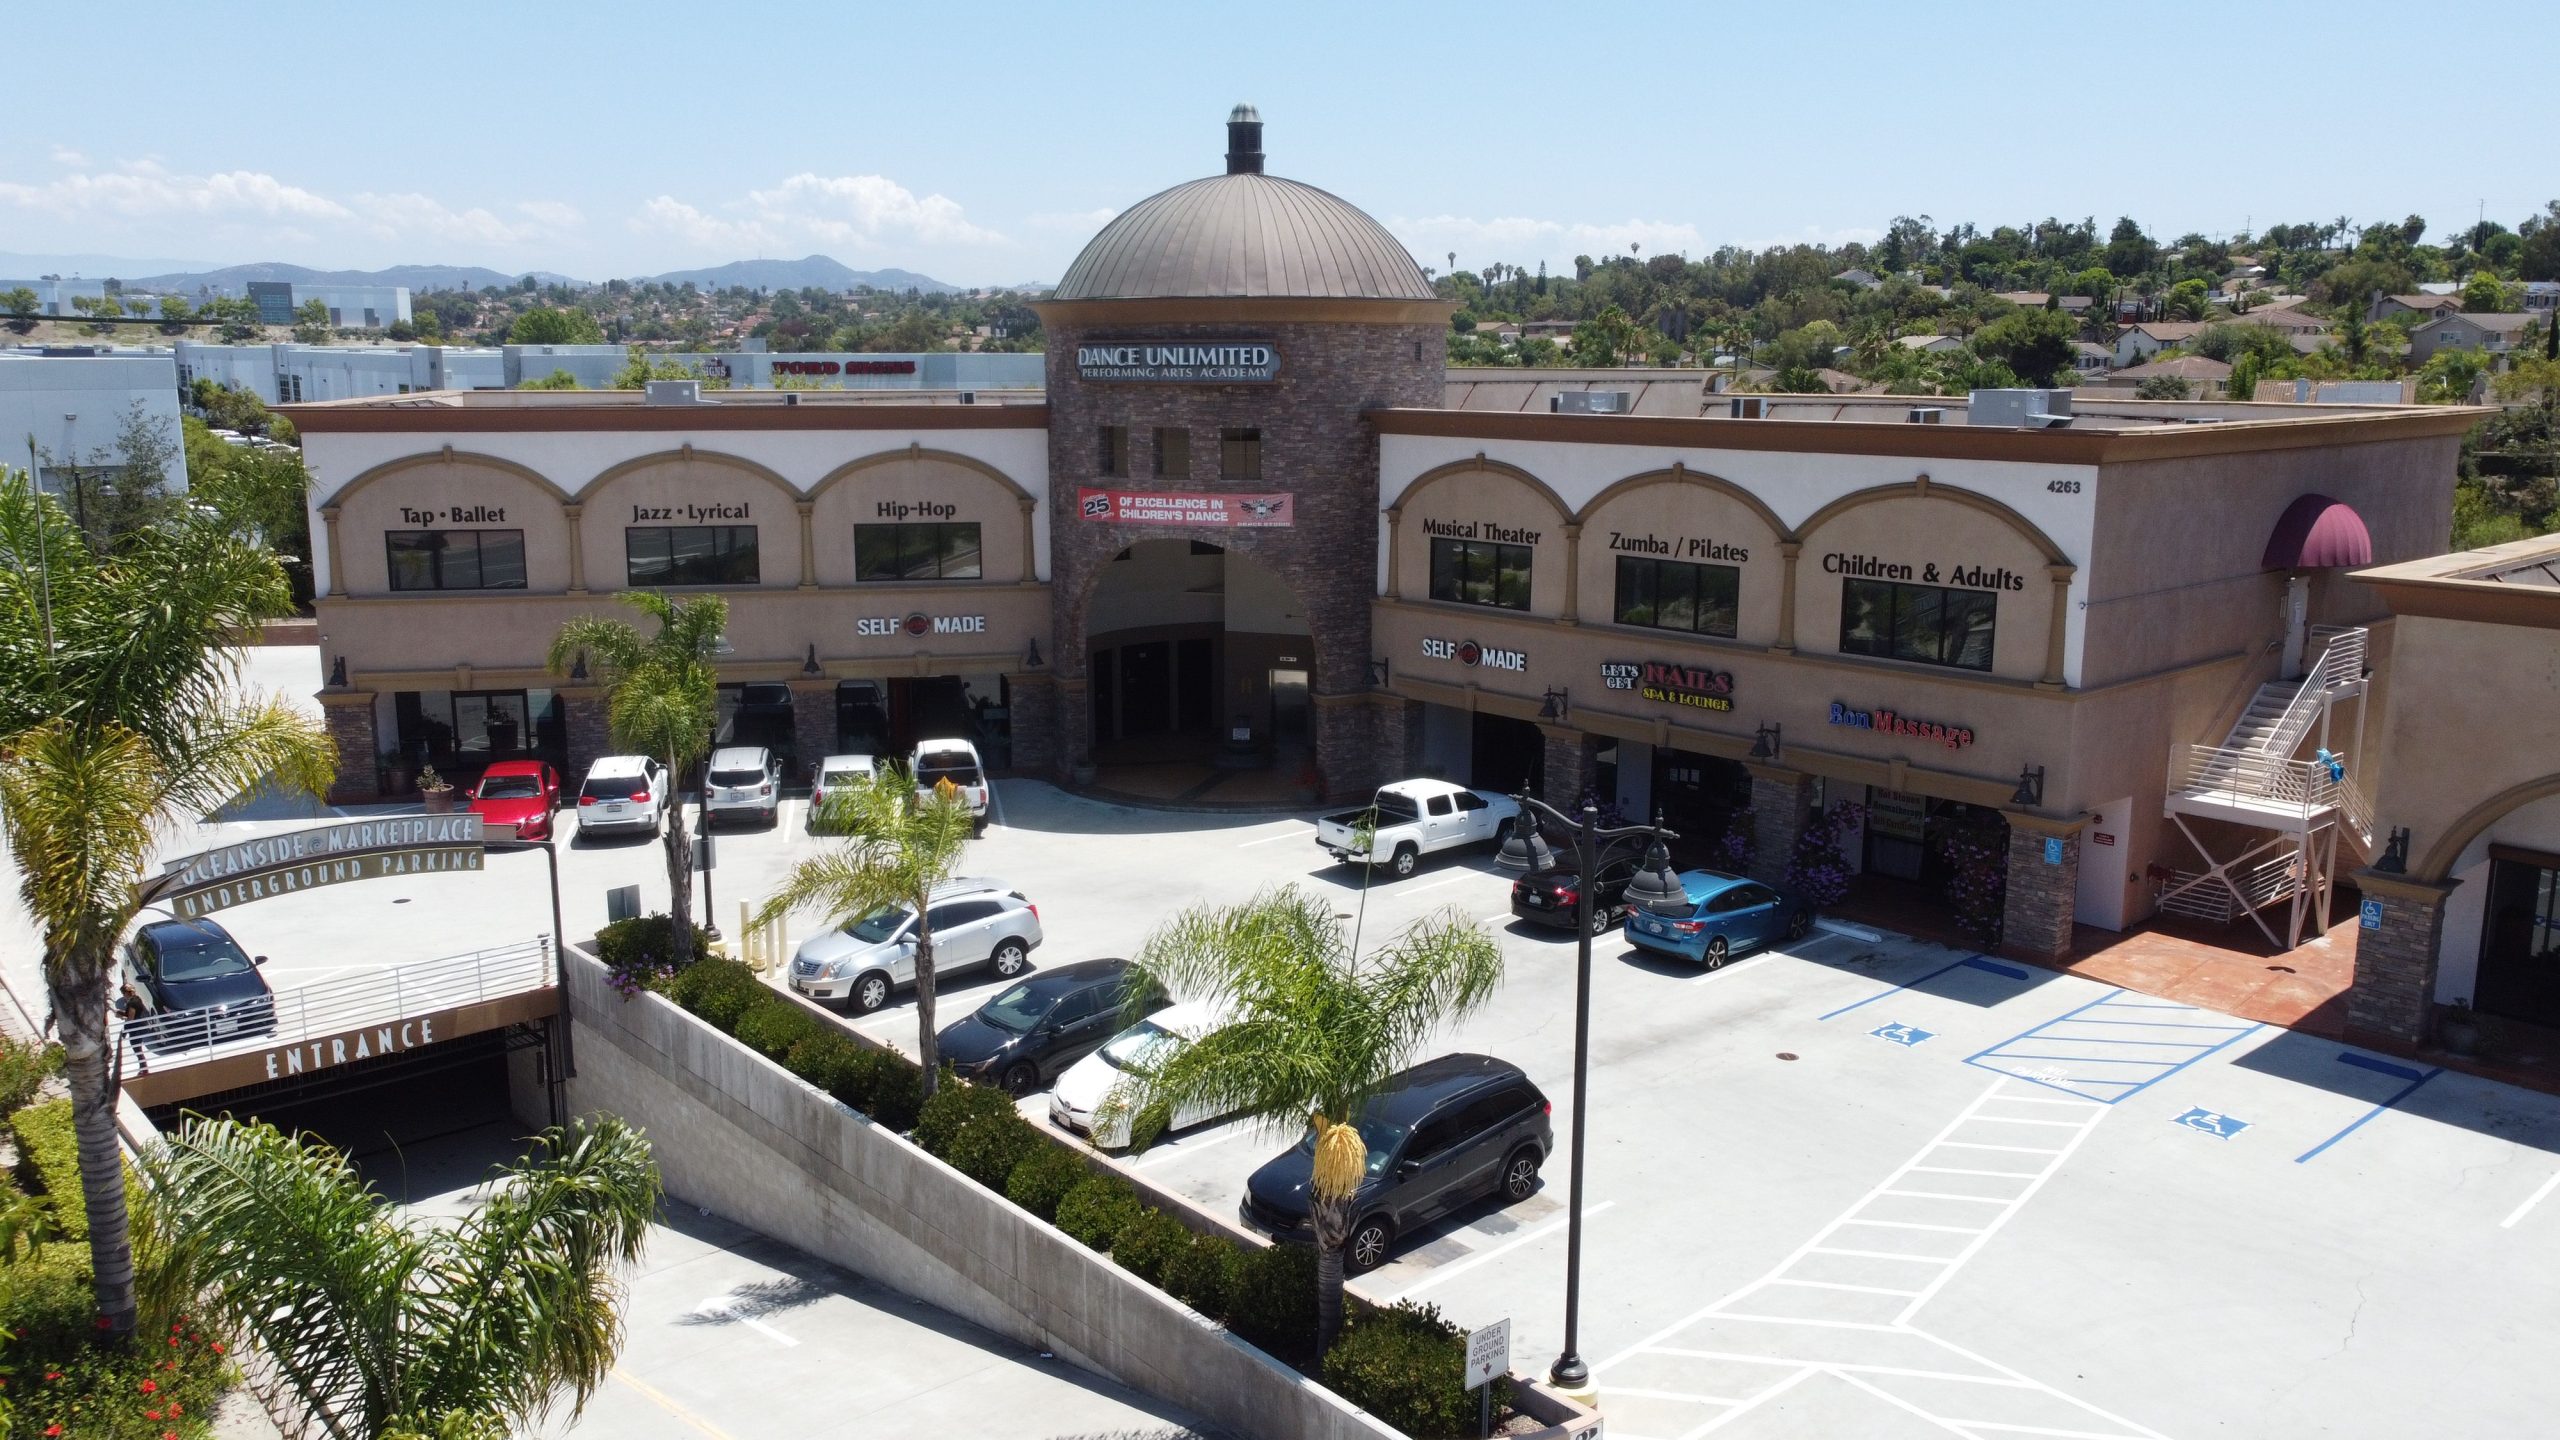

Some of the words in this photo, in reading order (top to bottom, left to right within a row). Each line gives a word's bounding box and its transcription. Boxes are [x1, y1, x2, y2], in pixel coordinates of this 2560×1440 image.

[1078, 347, 1140, 367] DANCE
[1146, 347, 1270, 366] UNLIMITED
[1082, 367, 1156, 378] PERFORMING
[1161, 367, 1193, 378] ARTS
[1199, 367, 1269, 378] ACADEMY
[2046, 480, 2081, 494] 4263
[633, 505, 672, 523] Jazz
[688, 502, 749, 523] Lyrical
[877, 501, 957, 520] Hip-Hop
[1084, 497, 1111, 517] 25
[1119, 496, 1133, 507] OF
[1135, 497, 1208, 509] EXCELLENCE
[1210, 499, 1224, 509] IN
[400, 507, 435, 527] Tap
[451, 505, 505, 522] Ballet
[1119, 508, 1183, 520] CHILDREN'S
[1186, 511, 1229, 522] DANCE
[1423, 518, 1478, 538] Musical
[1483, 523, 1541, 544] Theater
[1609, 532, 1669, 554] Zumba
[1689, 539, 1749, 562] Pilates
[1822, 553, 1913, 580] Children
[1922, 562, 1940, 583] &
[1949, 565, 2024, 591] Adults
[857, 618, 899, 636] SELF
[934, 616, 985, 633] MADE
[1422, 638, 1455, 660] SELF
[1482, 648, 1525, 672] MADE
[1601, 664, 1639, 677] LET'S
[1645, 662, 1732, 694] NAILS
[1606, 677, 1634, 689] GET
[1642, 687, 1666, 701] SPA
[1668, 691, 1676, 703] &
[1679, 693, 1730, 711] LOUNGE
[1829, 703, 1871, 730] Bon
[1873, 710, 1973, 750] Massage
[179, 835, 303, 886] OCEANSIDE
[327, 818, 474, 852] MARKETPLACE
[185, 859, 362, 917] UNDERGROUND
[382, 851, 478, 874] PARKING
[265, 1019, 434, 1079] ENTRANCE
[1476, 1326, 1502, 1345] UNDER
[1472, 1336, 1505, 1357] GROUND
[1471, 1349, 1505, 1369] PARKING
